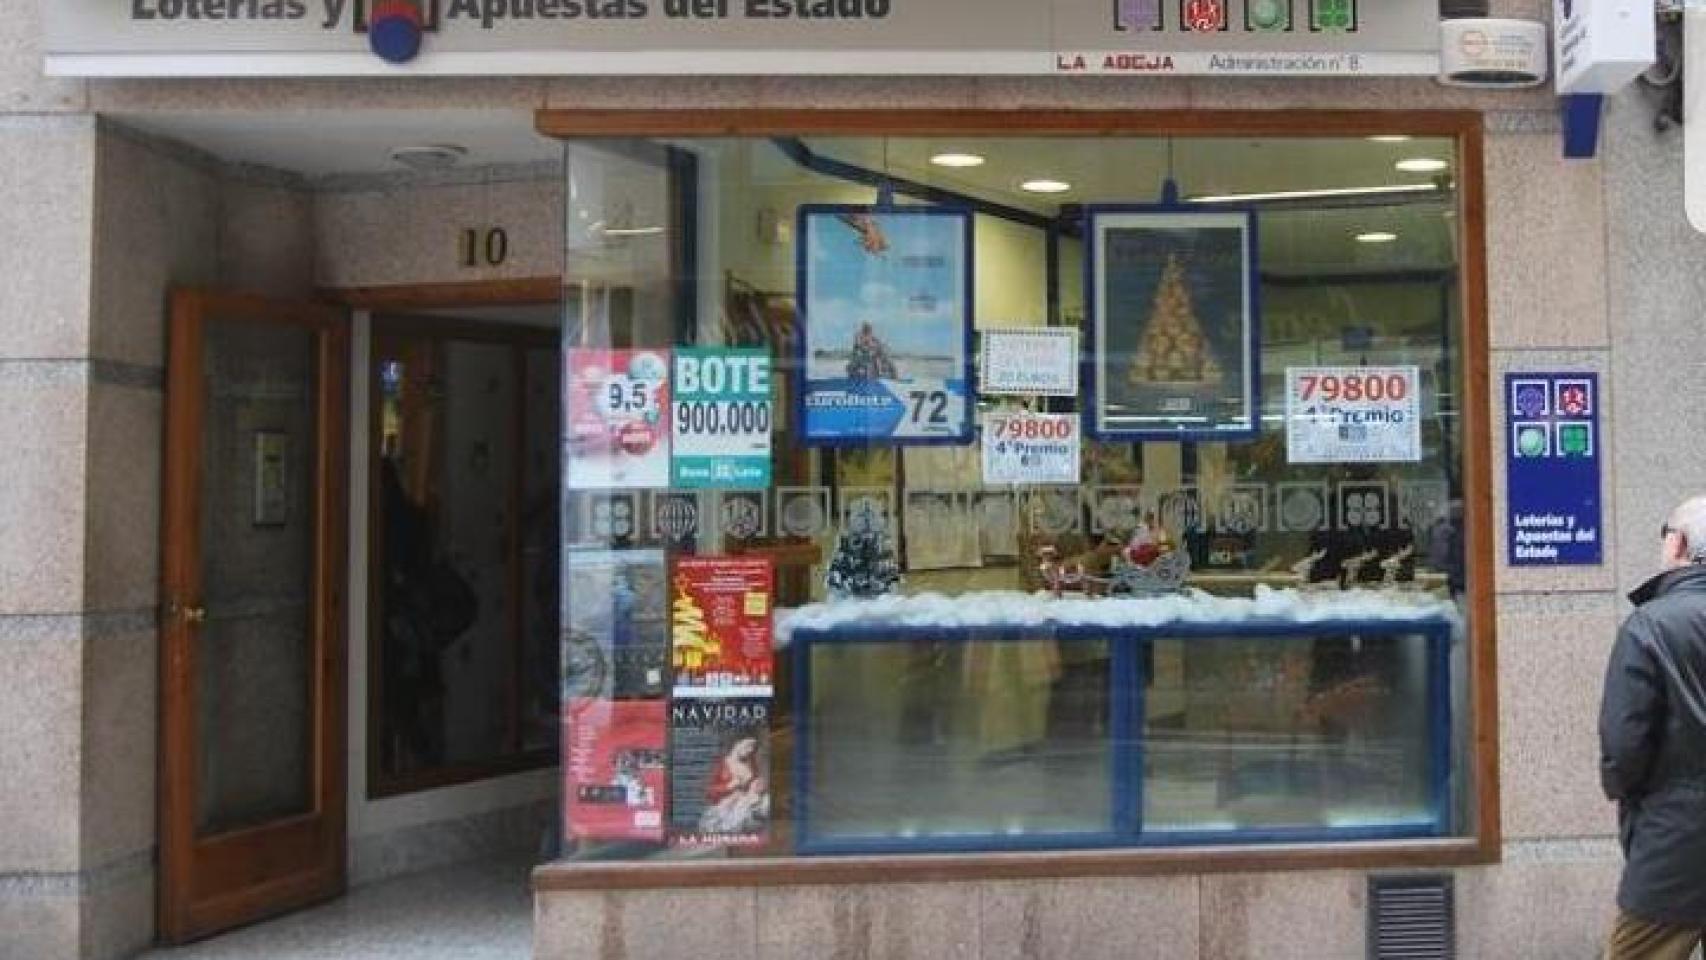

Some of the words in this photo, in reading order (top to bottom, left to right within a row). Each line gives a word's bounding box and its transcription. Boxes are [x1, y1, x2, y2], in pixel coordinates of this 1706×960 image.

[322, 0, 347, 29] y
[446, 0, 647, 28] Apuestas
[664, 0, 728, 19] del
[743, 0, 890, 19] Estado
[1056, 54, 1087, 70] LA
[462, 227, 508, 267] 10
[676, 355, 770, 394] BOTE
[1298, 374, 1406, 401] 79800
[608, 383, 648, 411] 9,5
[909, 391, 949, 423] 72
[678, 401, 769, 434] 900.000
[992, 419, 1072, 439] 79800
[672, 704, 767, 720] NAVIDAD
